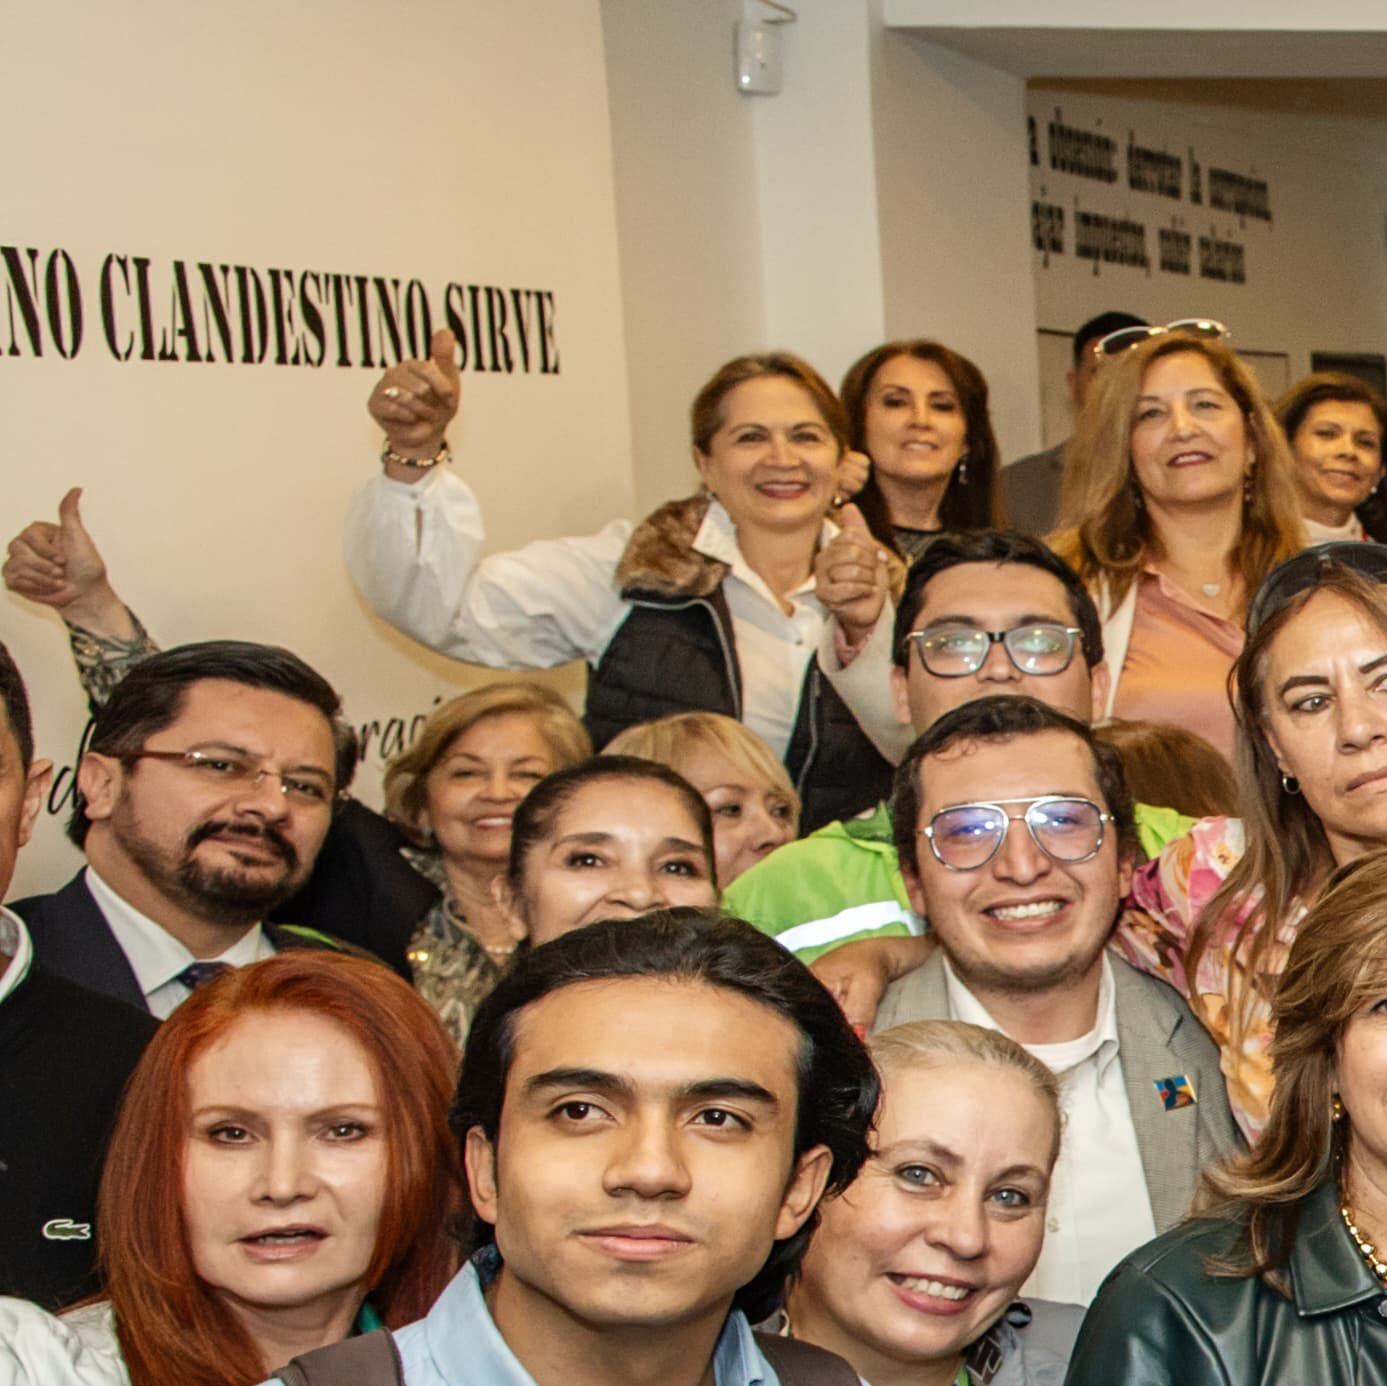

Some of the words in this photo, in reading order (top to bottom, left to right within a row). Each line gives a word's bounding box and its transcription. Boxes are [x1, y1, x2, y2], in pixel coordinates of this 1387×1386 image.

[0, 245, 84, 361] NO
[100, 252, 433, 369] CLANDESTINO
[445, 281, 560, 375] SIRVE
